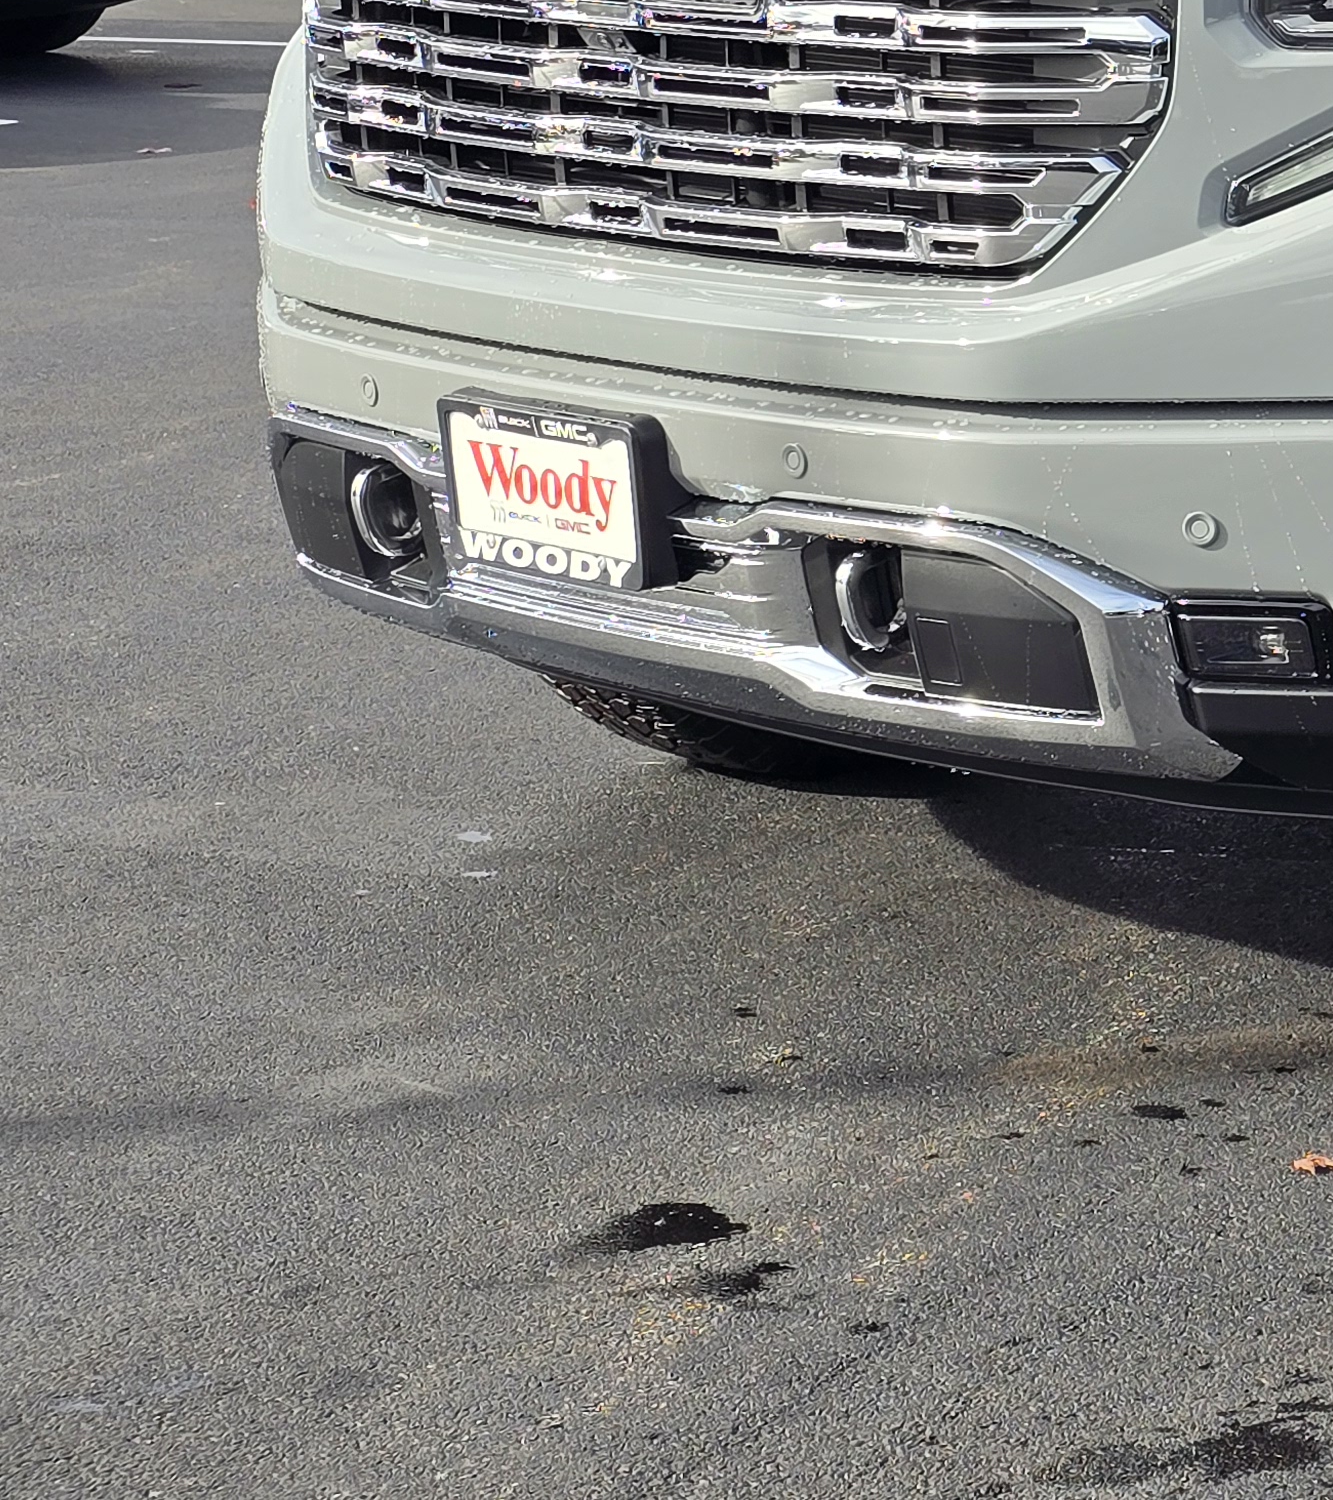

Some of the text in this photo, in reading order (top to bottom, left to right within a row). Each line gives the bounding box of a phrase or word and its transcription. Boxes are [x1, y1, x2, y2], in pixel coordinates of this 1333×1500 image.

[540, 418, 588, 442] GMC
[467, 439, 617, 532] Woody
[554, 517, 591, 535] GMC
[460, 529, 632, 588] WOODY
